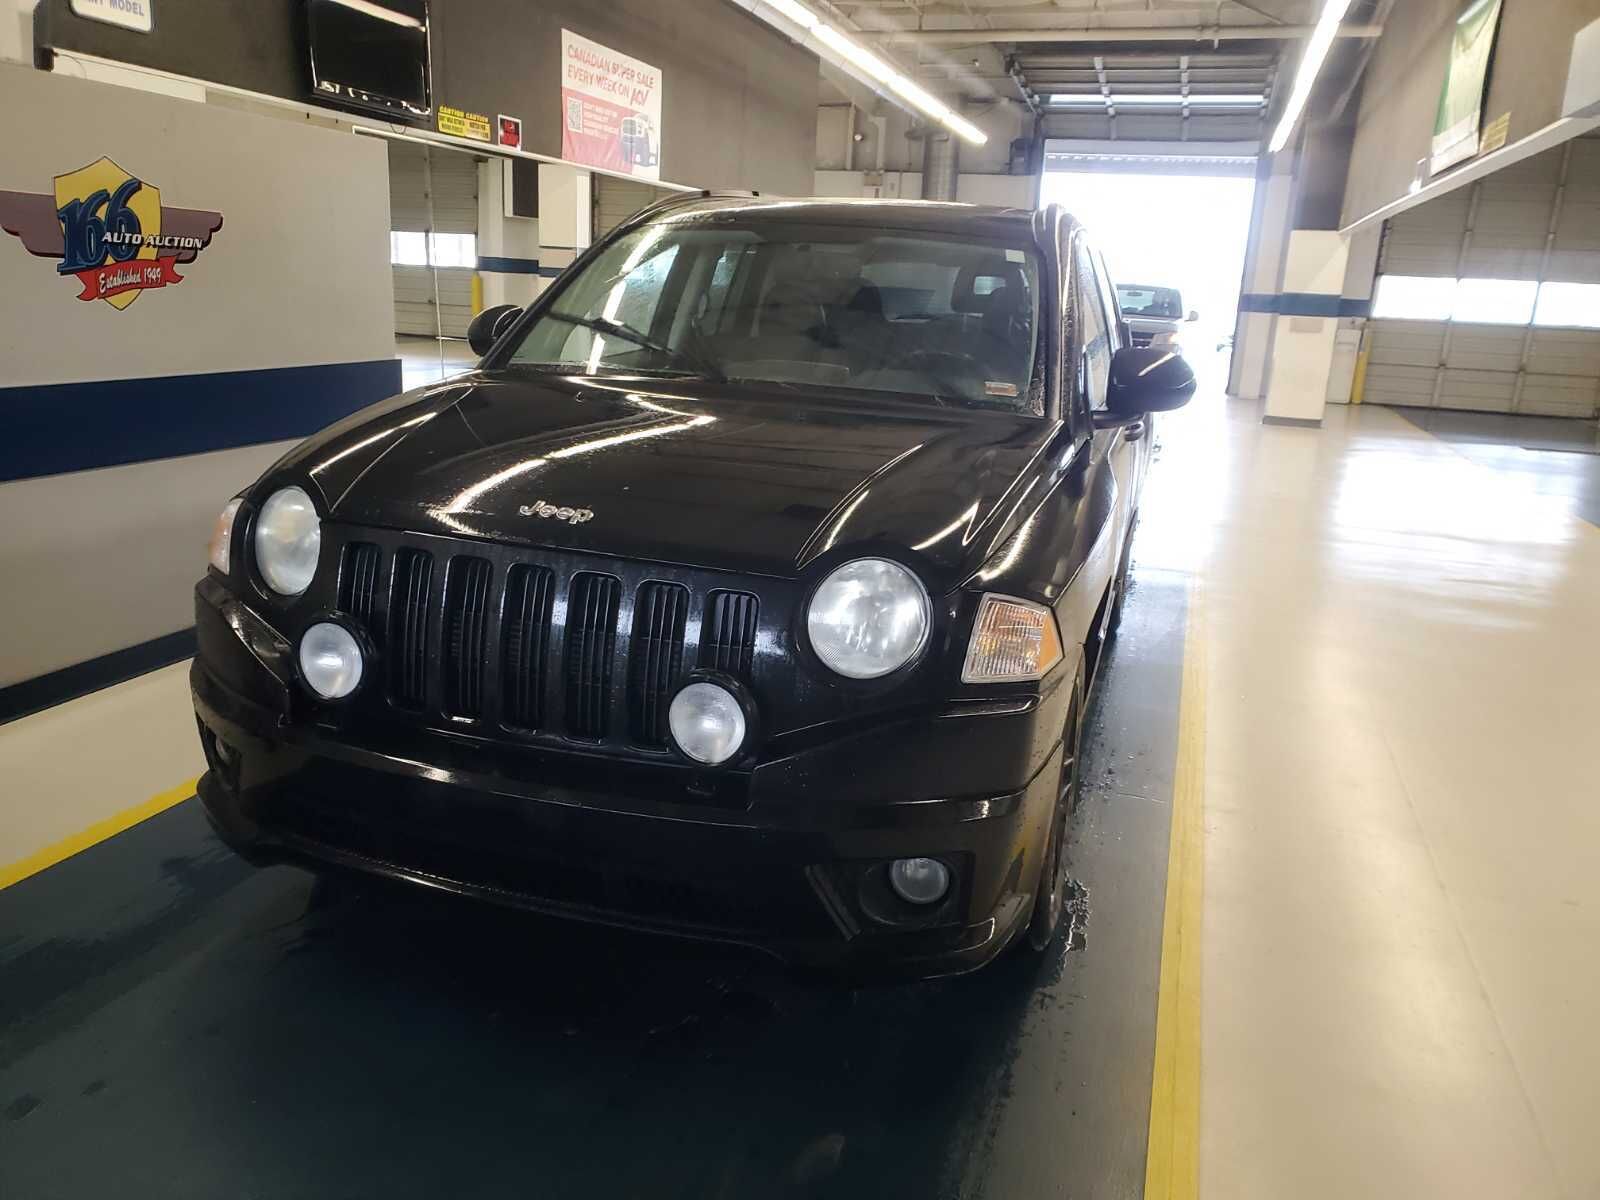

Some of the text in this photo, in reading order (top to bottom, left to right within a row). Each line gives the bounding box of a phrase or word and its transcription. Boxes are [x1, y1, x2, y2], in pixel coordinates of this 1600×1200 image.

[110, 0, 144, 16] MODEL
[567, 44, 610, 72] CANADIAN
[637, 72, 655, 88] SALE
[567, 64, 594, 86] EVERY
[596, 74, 618, 94] WEEK
[618, 82, 630, 98] ON
[56, 178, 143, 275] 166
[102, 231, 204, 249] AUTO AUCTION
[99, 266, 142, 293] Established
[519, 500, 594, 525] Jeep
